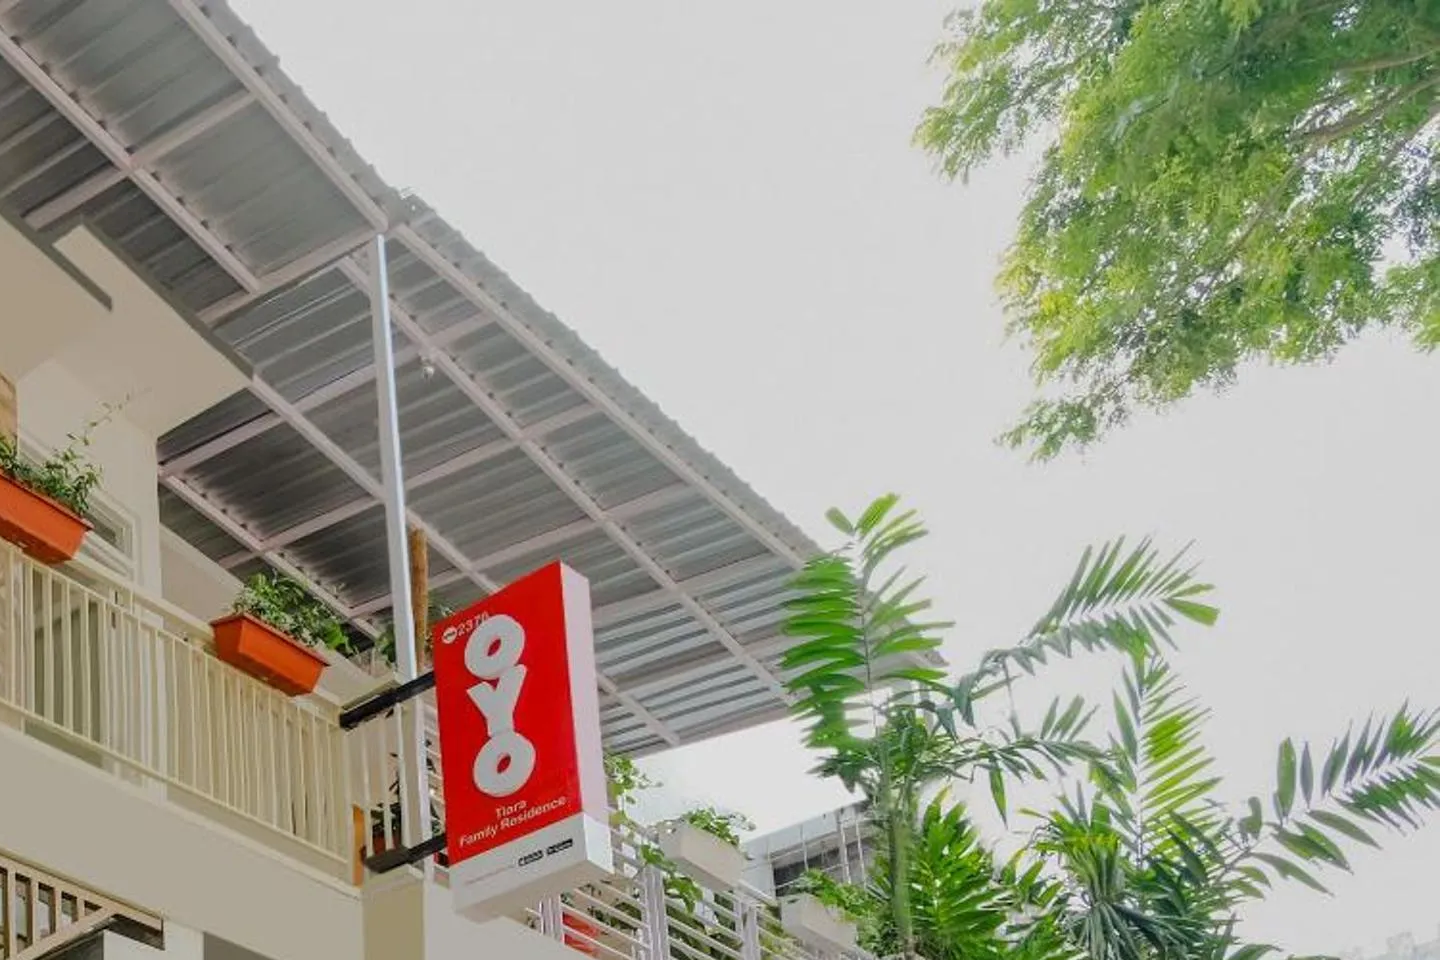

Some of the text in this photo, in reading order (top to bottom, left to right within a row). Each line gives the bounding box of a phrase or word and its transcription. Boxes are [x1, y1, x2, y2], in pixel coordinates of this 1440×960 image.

[464, 614, 536, 798] OYO
[459, 796, 566, 847] Family Residence
